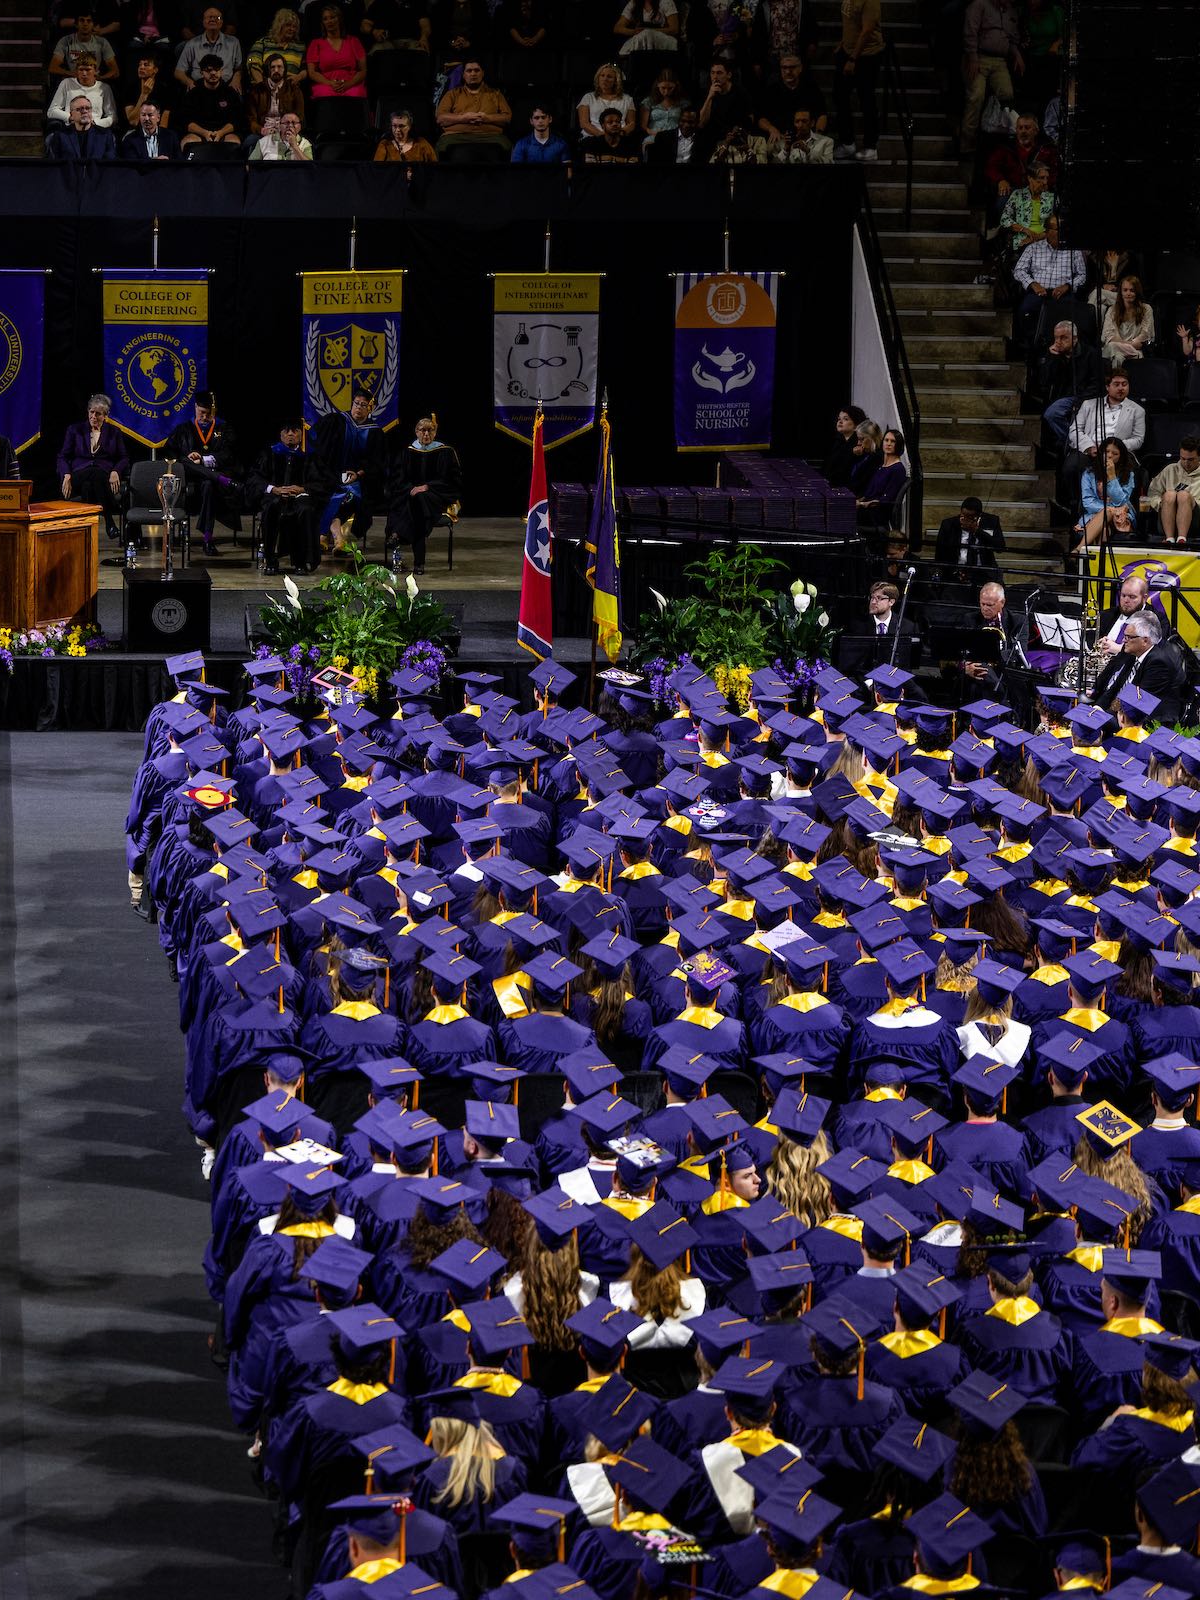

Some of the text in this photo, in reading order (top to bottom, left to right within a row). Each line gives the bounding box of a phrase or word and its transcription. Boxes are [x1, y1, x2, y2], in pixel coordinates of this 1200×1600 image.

[313, 281, 391, 292] COLLEGE OF
[120, 290, 192, 301] COLLEGE OF
[313, 292, 392, 305] FINE ARTS
[114, 304, 197, 315] ENGINEERING
[122, 333, 181, 355] ENGINEERING
[174, 359, 197, 412] COMPUTING
[114, 370, 158, 418] TECHNOLOGY
[696, 409, 750, 419] SCHOOL OF
[695, 418, 749, 429] NURSING
